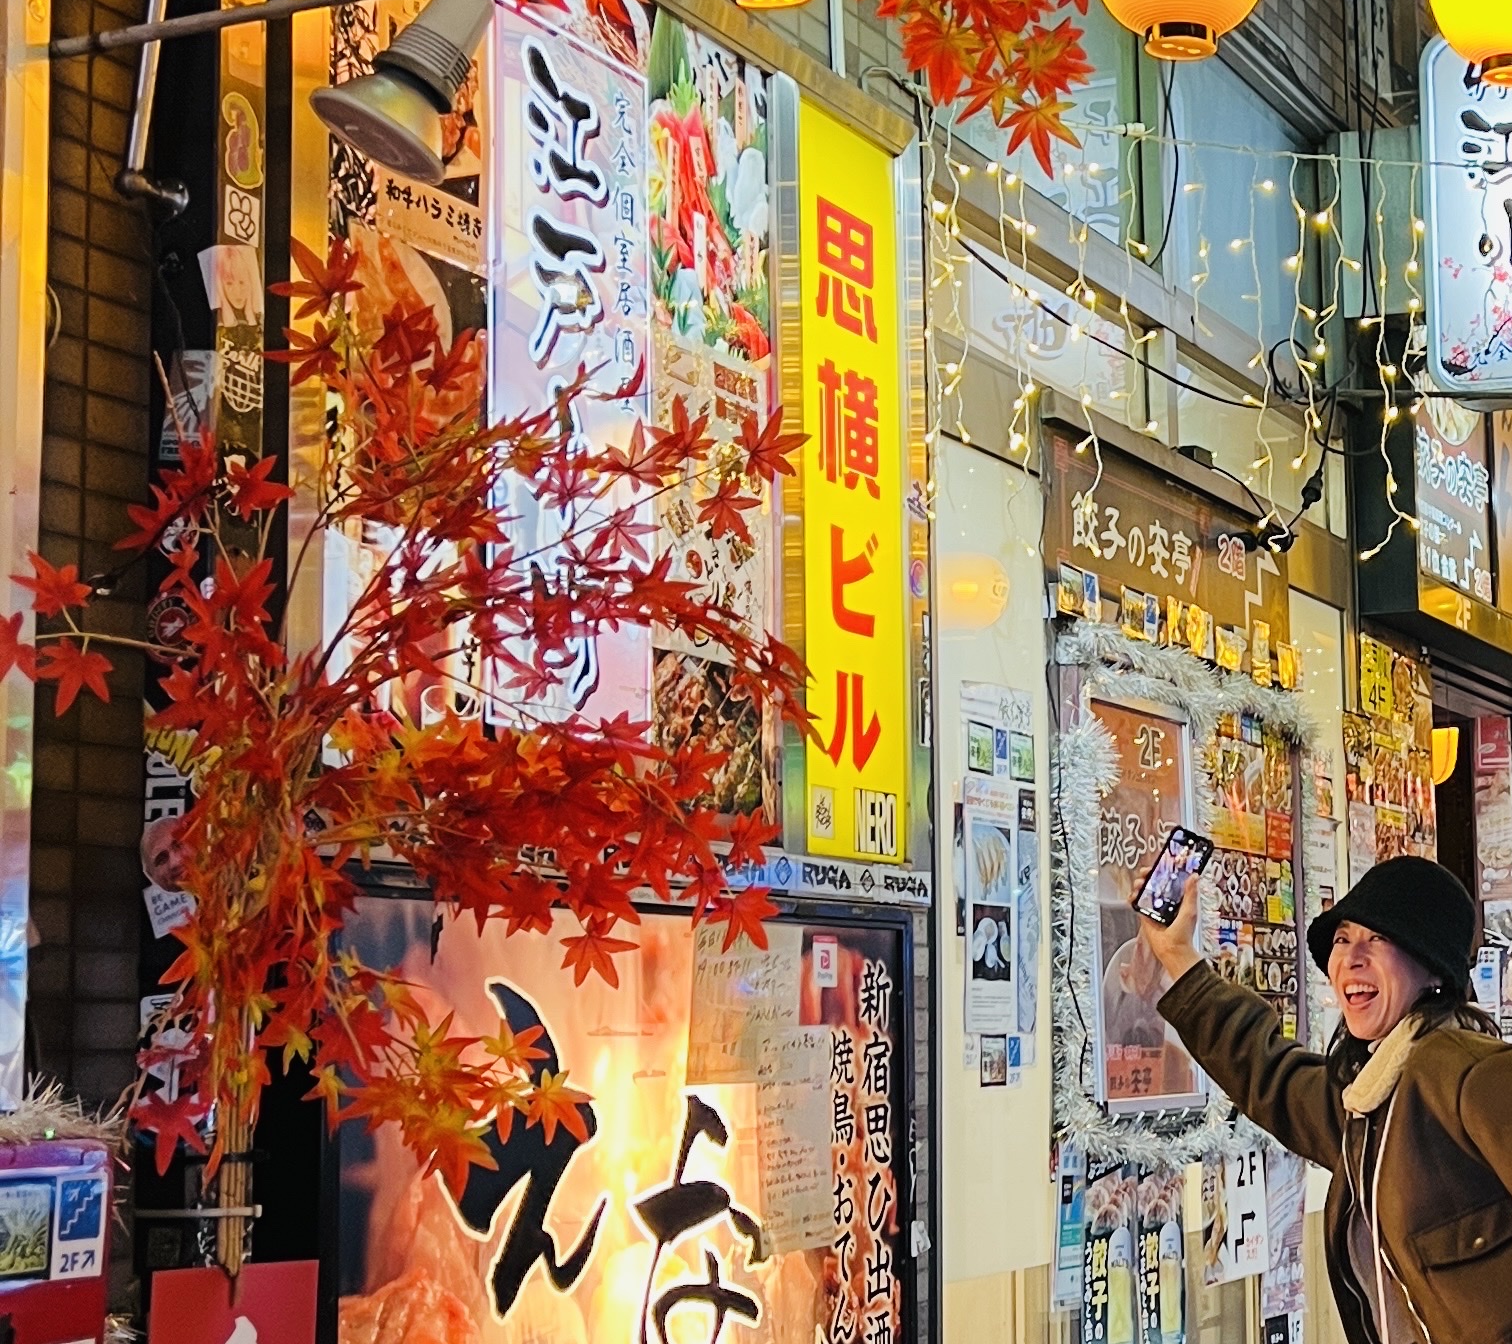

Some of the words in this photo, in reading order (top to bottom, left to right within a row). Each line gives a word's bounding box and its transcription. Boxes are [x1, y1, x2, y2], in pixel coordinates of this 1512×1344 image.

[814, 192, 883, 774] 思横ビル
[1455, 597, 1472, 631] 2F
[854, 788, 898, 855] NERO
[801, 863, 852, 890] RUGA
[882, 874, 929, 898] RUGA
[1236, 1150, 1258, 1188] 2F
[60, 1253, 79, 1274] 2F
